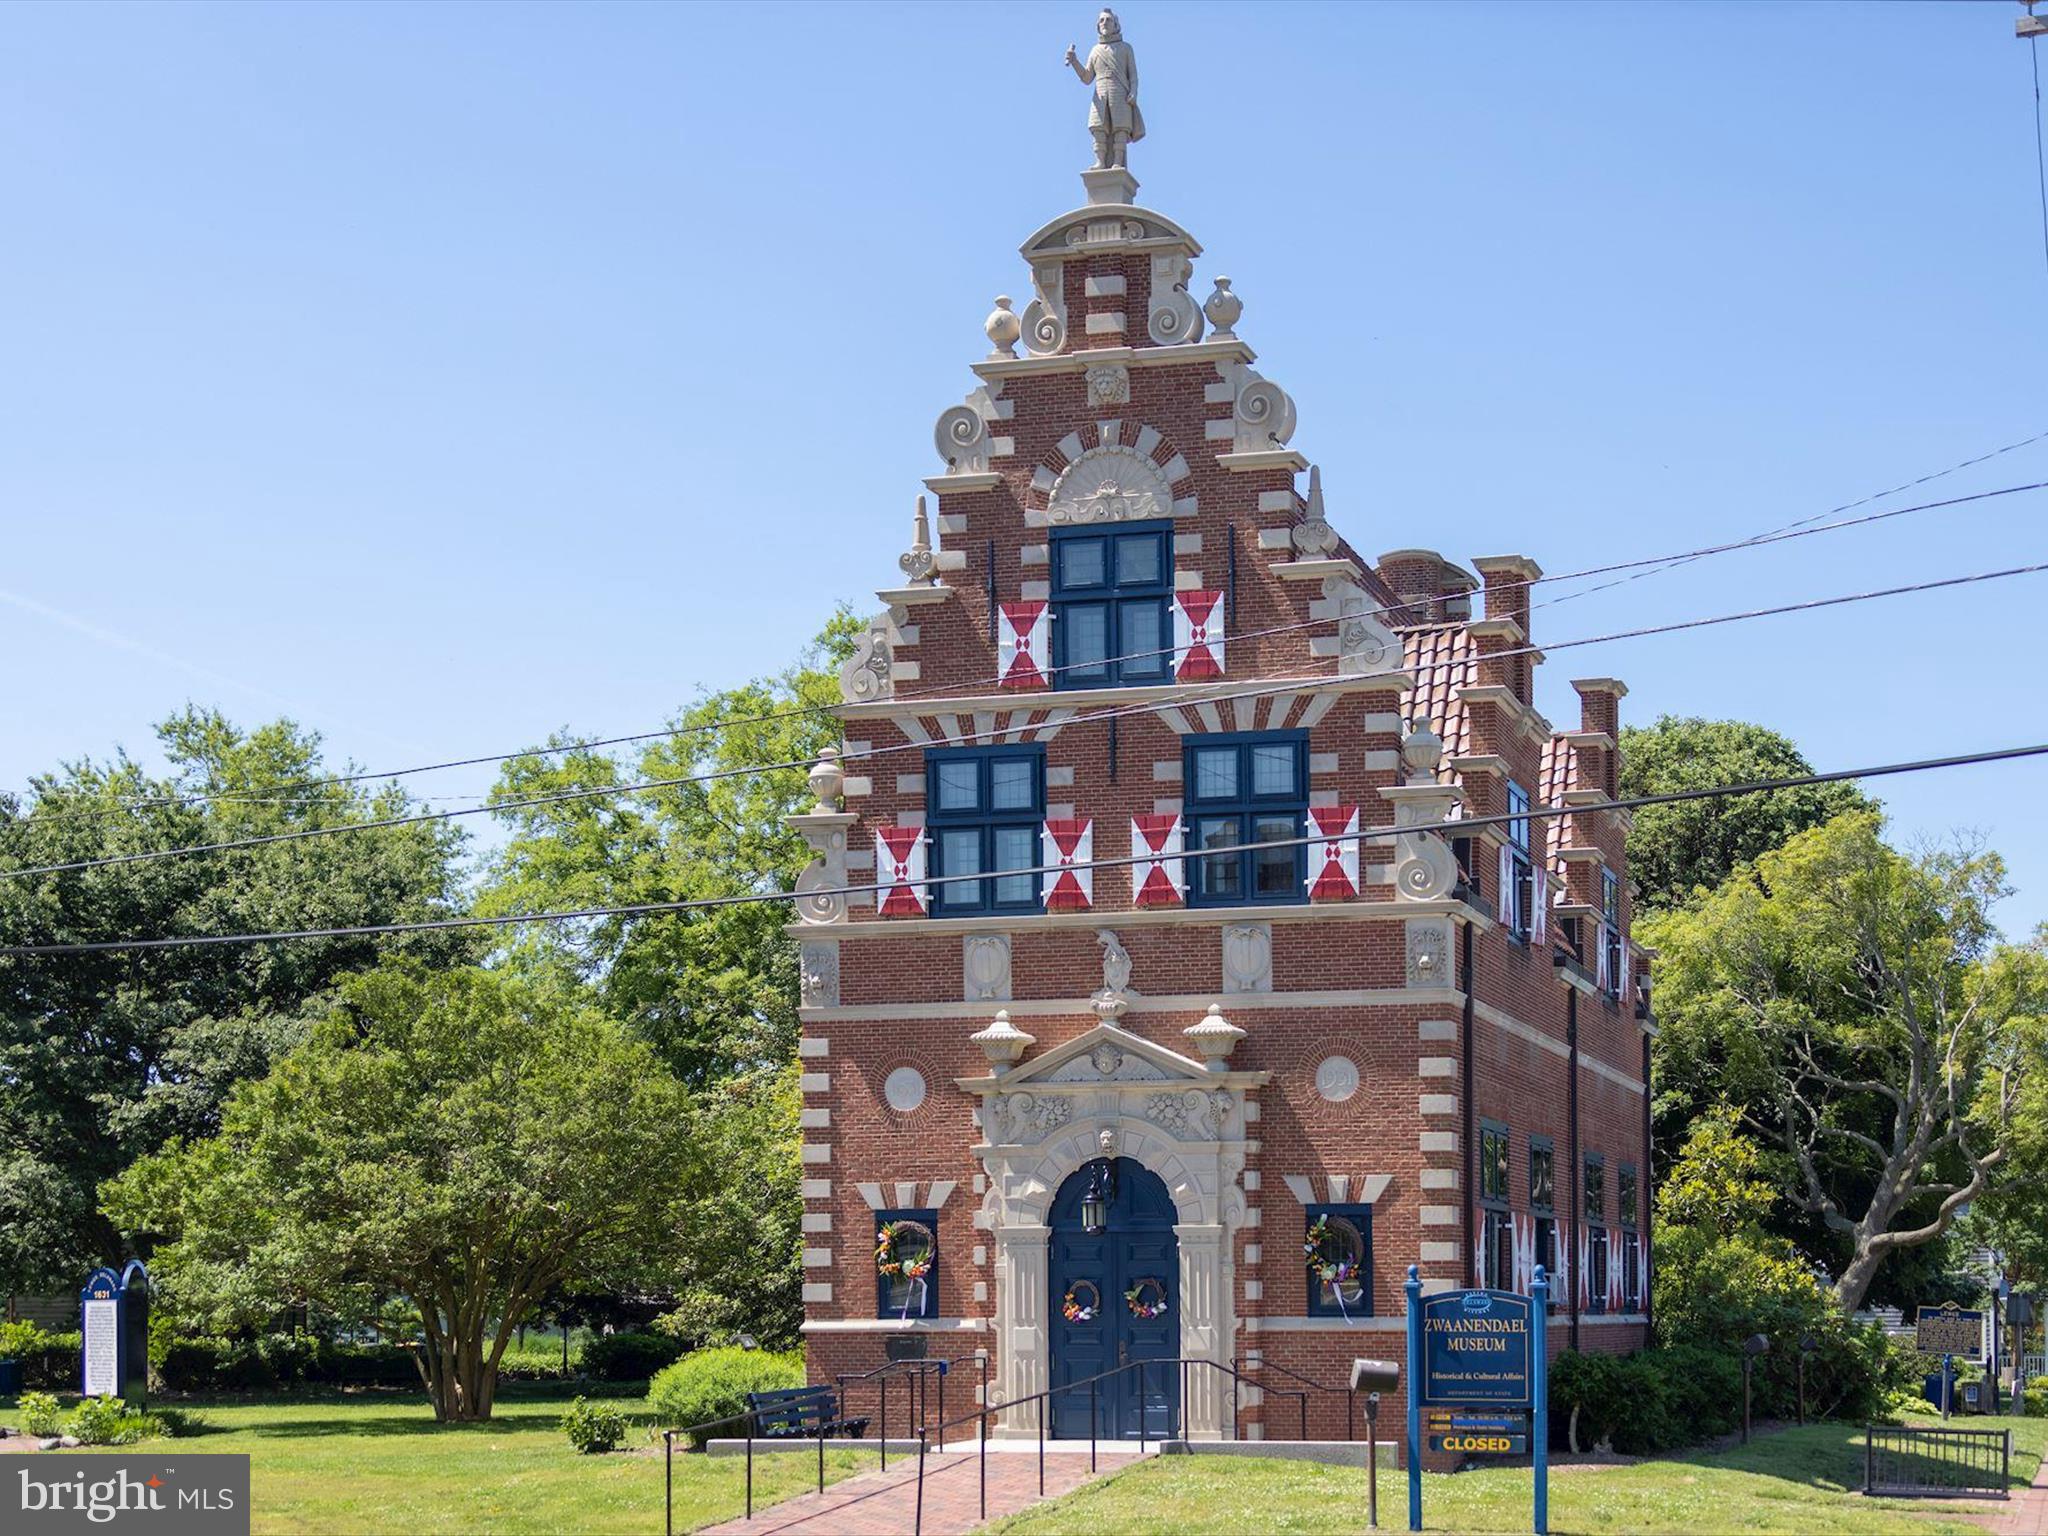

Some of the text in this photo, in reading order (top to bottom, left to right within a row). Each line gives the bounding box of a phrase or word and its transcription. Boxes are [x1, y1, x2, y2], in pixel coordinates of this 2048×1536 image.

[1424, 1318, 1528, 1333] ZWAANENDAEL
[1447, 1338, 1506, 1352] MUSEUM
[1432, 1371, 1525, 1380] Historical & Cultural Affairs
[1442, 1437, 1511, 1452] CLOSED
